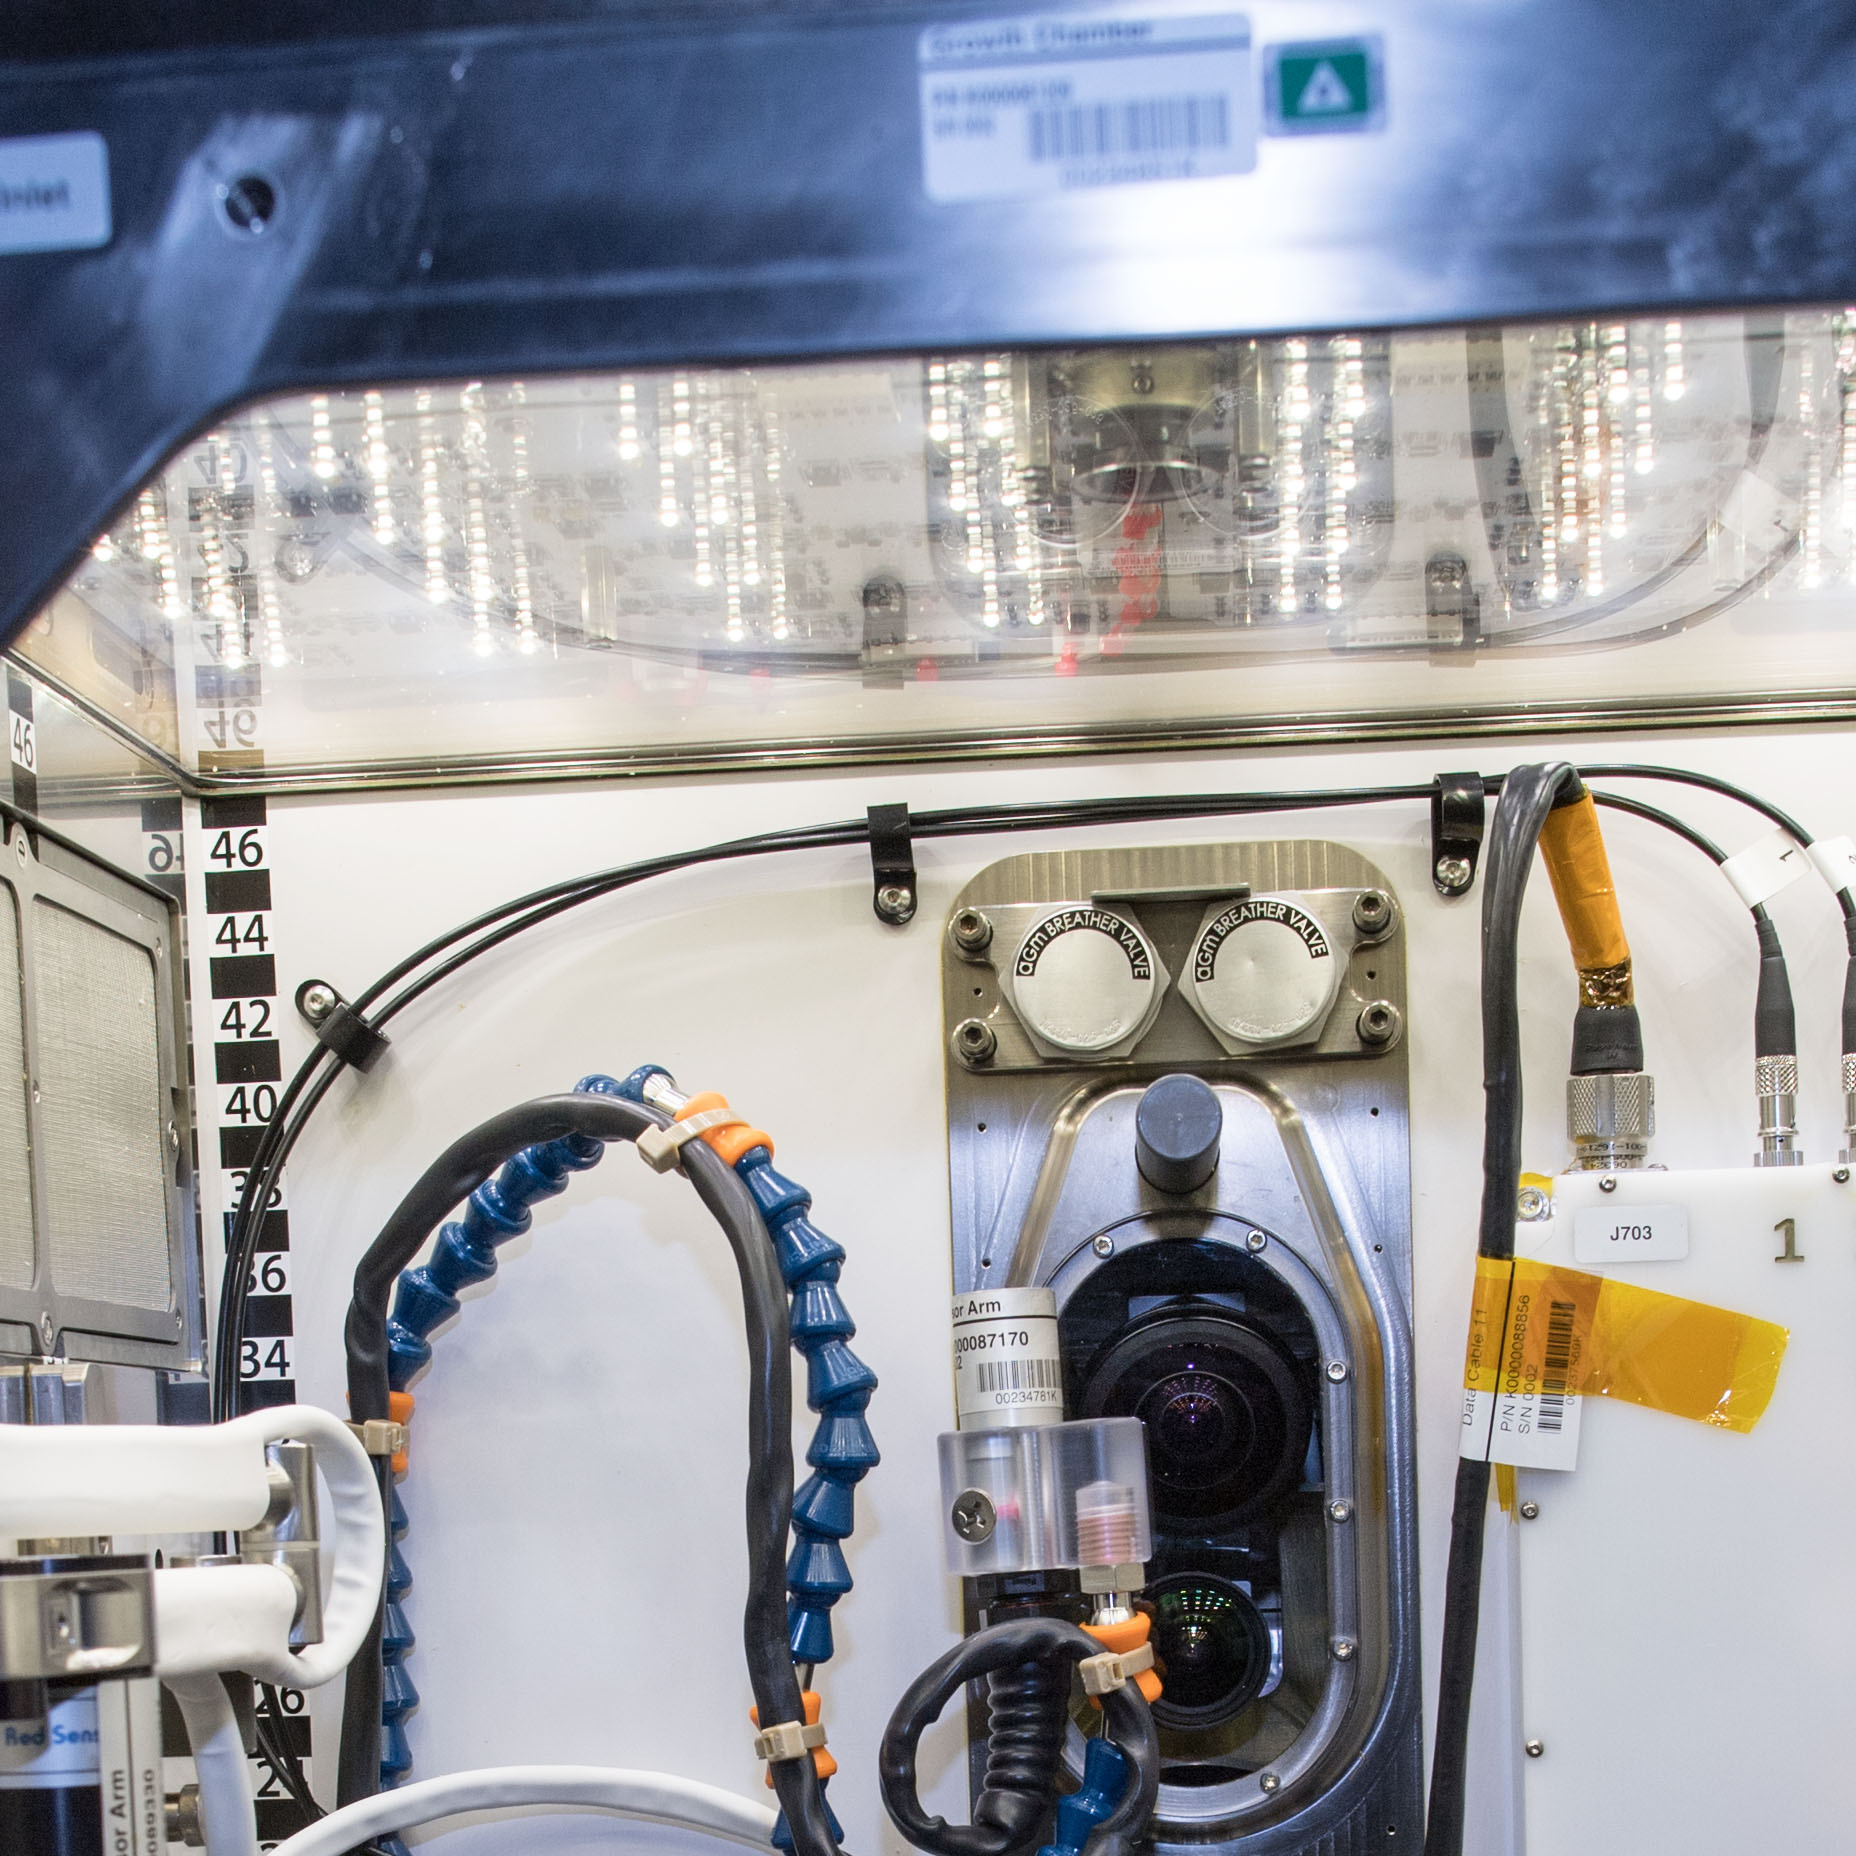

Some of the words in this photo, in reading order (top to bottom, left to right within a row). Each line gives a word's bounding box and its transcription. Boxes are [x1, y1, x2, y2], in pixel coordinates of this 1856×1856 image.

[210, 828, 263, 868] 46
[214, 914, 268, 953] 44
[1044, 910, 1120, 938] BREATHER
[1118, 924, 1150, 978] VALVE
[1213, 901, 1288, 936] BREATHER
[1289, 909, 1329, 960] VALVE
[220, 999, 272, 1038] 42
[225, 1085, 277, 1124] 40
[1609, 1224, 1653, 1243] J703
[1773, 1218, 1806, 1264] 1
[968, 1299, 1001, 1316] Arm
[1467, 1334, 1484, 1382] Cable
[1504, 1294, 1531, 1400] K0000088856
[1522, 1363, 1539, 1402] 0002
[1462, 1388, 1478, 1427] Data
[1500, 1404, 1517, 1433] P/N
[1518, 1406, 1533, 1435] S/N
[110, 1769, 127, 1820] Arm
